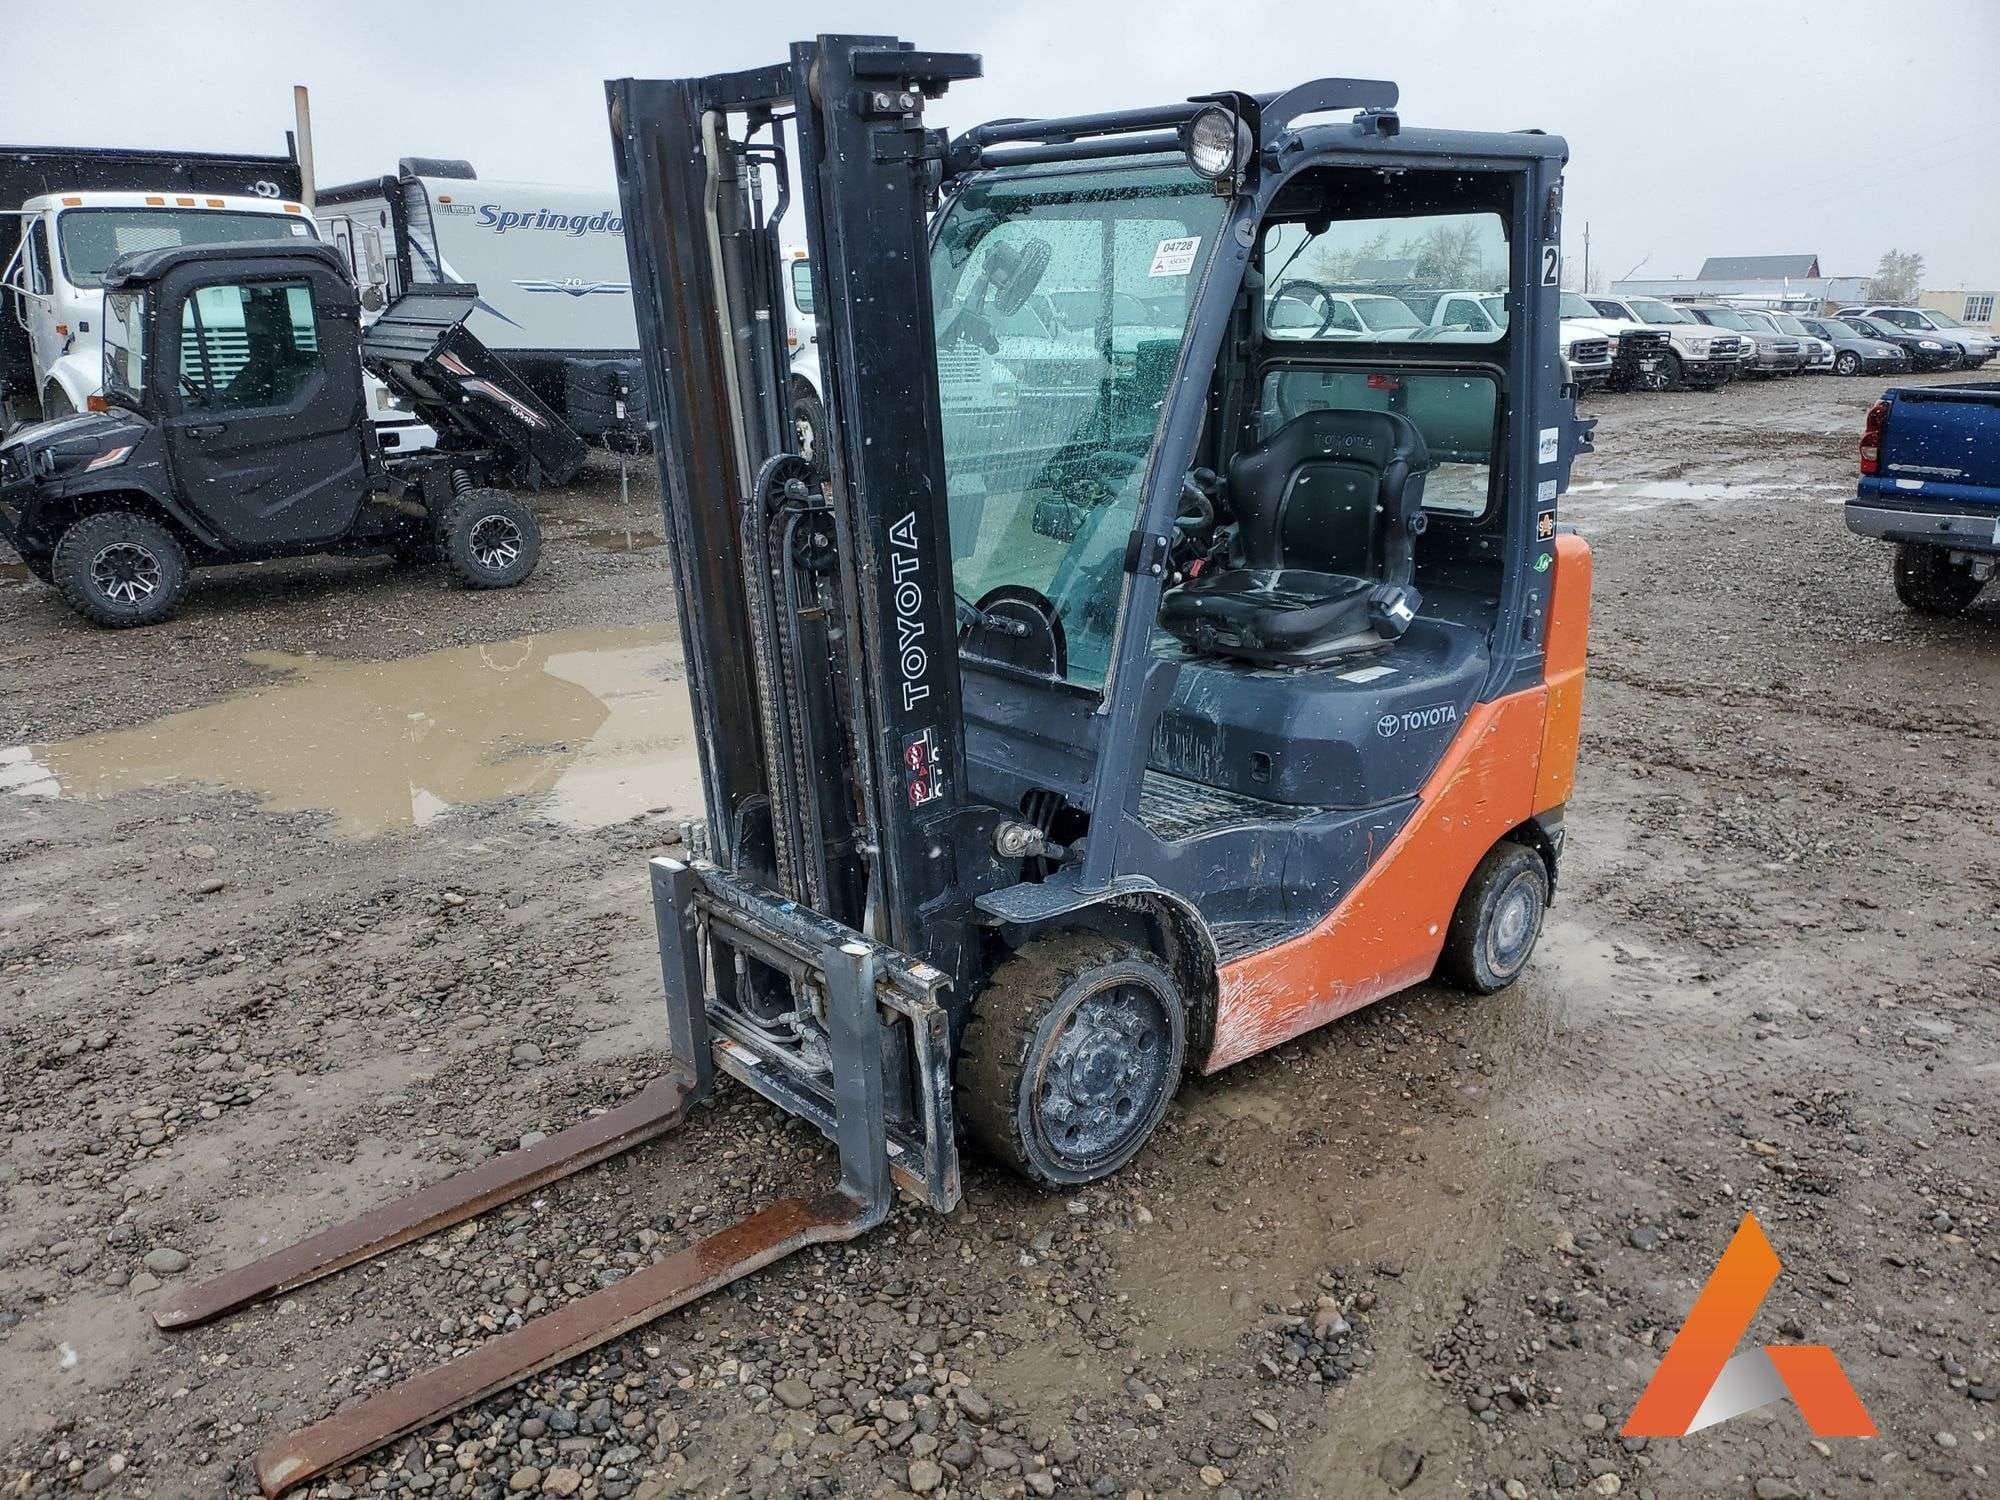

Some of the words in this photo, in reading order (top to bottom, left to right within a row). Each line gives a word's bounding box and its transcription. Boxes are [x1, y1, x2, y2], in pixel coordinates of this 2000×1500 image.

[1163, 240, 1193, 253] 04728
[1543, 247, 1558, 285] 2
[888, 511, 930, 712] TOYOTA
[1401, 705, 1457, 731] TOYOTA
